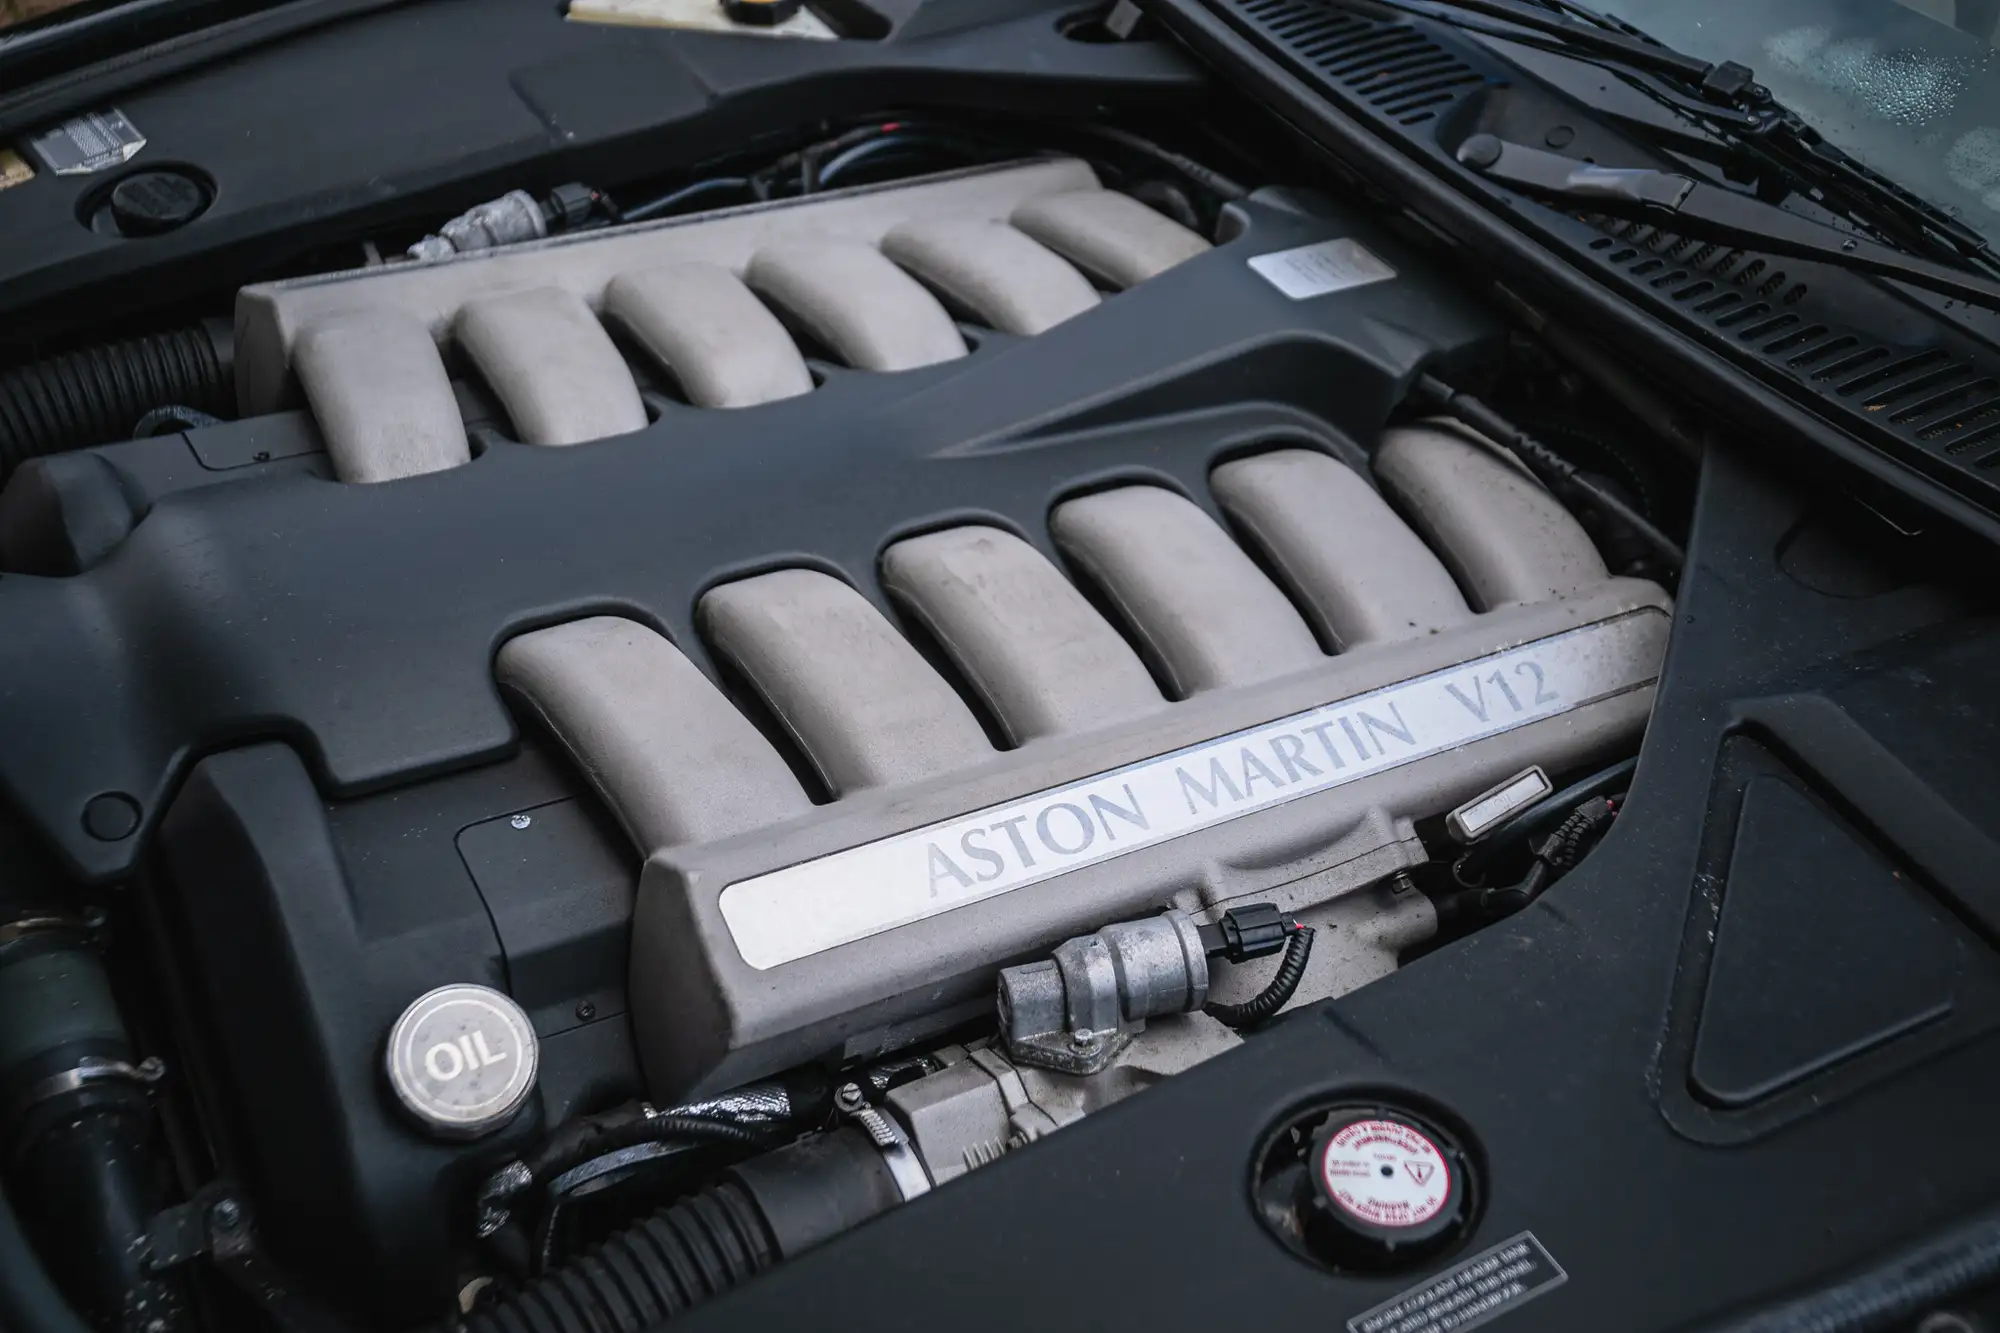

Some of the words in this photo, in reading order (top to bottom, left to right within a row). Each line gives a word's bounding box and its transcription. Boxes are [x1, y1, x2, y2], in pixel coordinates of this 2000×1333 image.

[927, 783, 1151, 898] ASTON
[1174, 701, 1417, 816] MARTIN
[1443, 660, 1561, 724] V12
[425, 1029, 508, 1082] OIL
